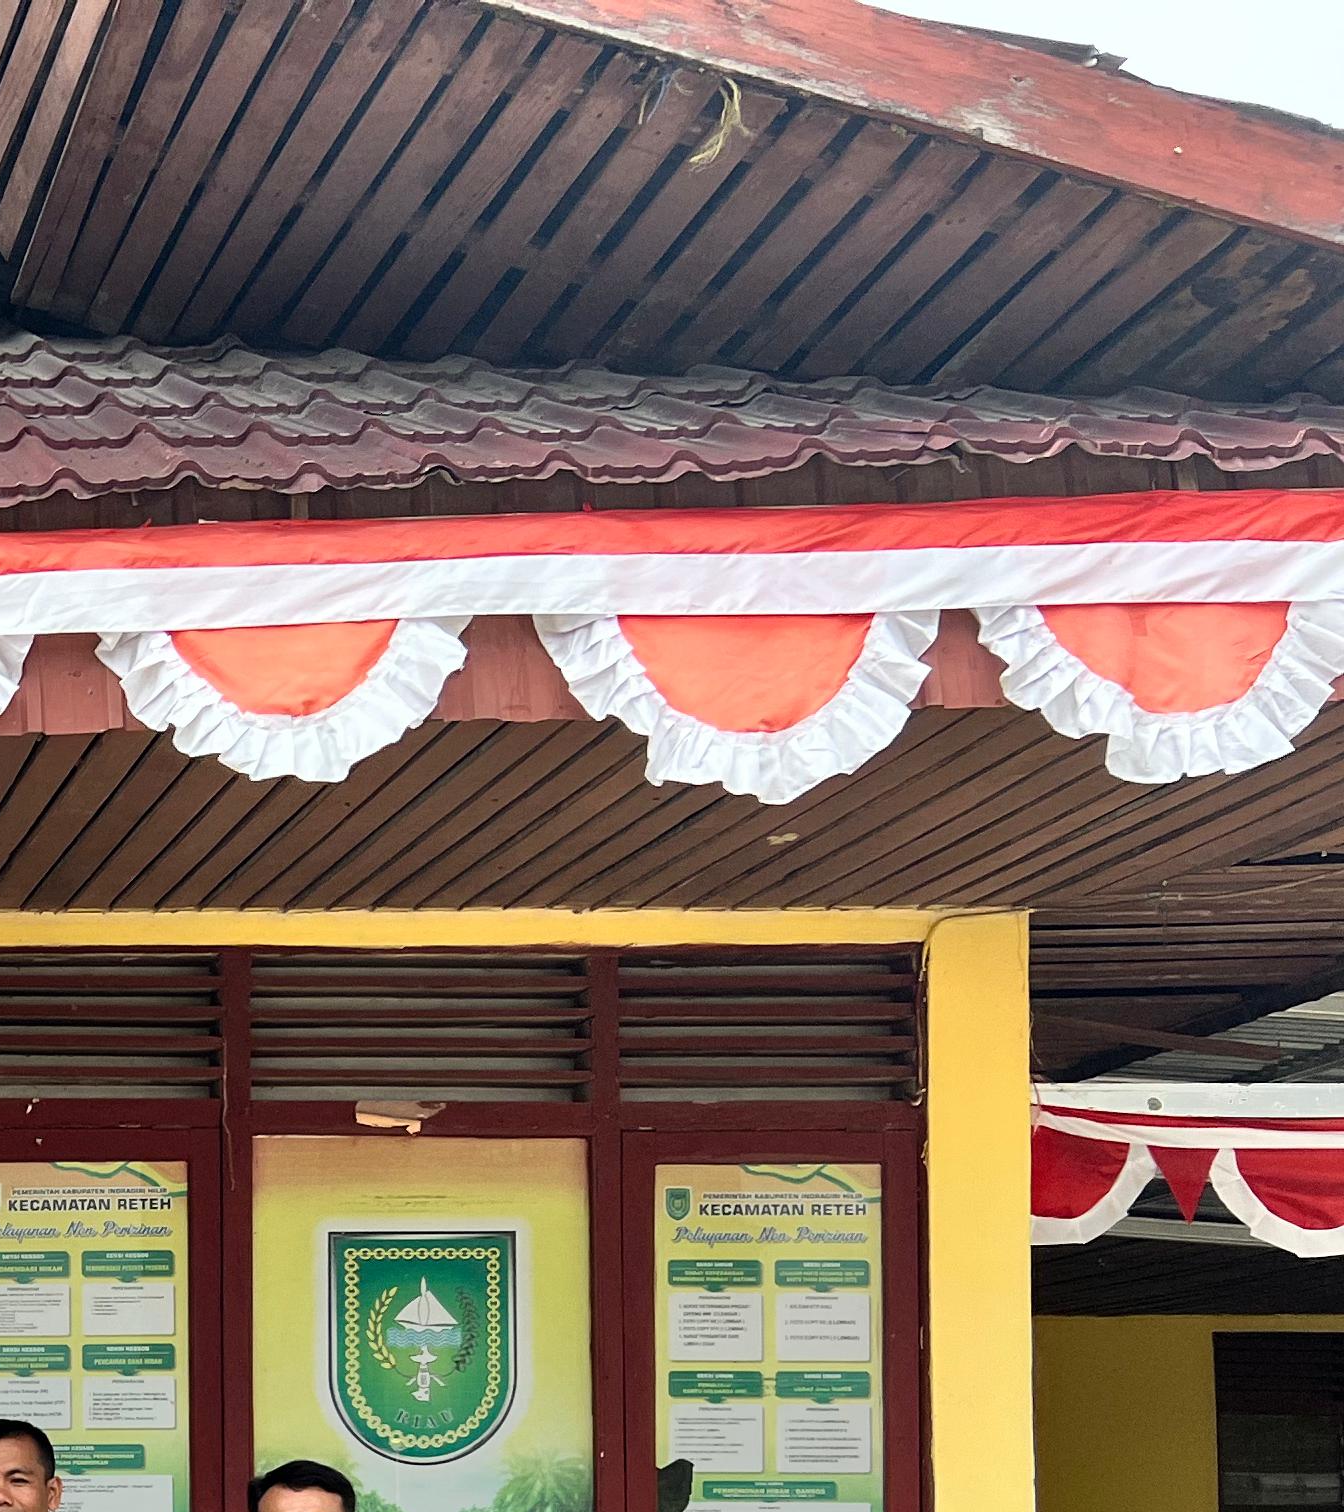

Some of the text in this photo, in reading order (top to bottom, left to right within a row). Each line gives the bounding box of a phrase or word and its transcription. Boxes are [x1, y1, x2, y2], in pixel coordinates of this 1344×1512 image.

[8, 1198, 172, 1212] KECAMATAN RETEH
[699, 1203, 867, 1216] KECAMATAN RETEH
[65, 1221, 97, 1238] Non
[100, 1221, 173, 1238] Perizinan
[672, 1226, 867, 1248] Pelayanan Non Perizinan
[395, 1410, 453, 1428] RIAU
